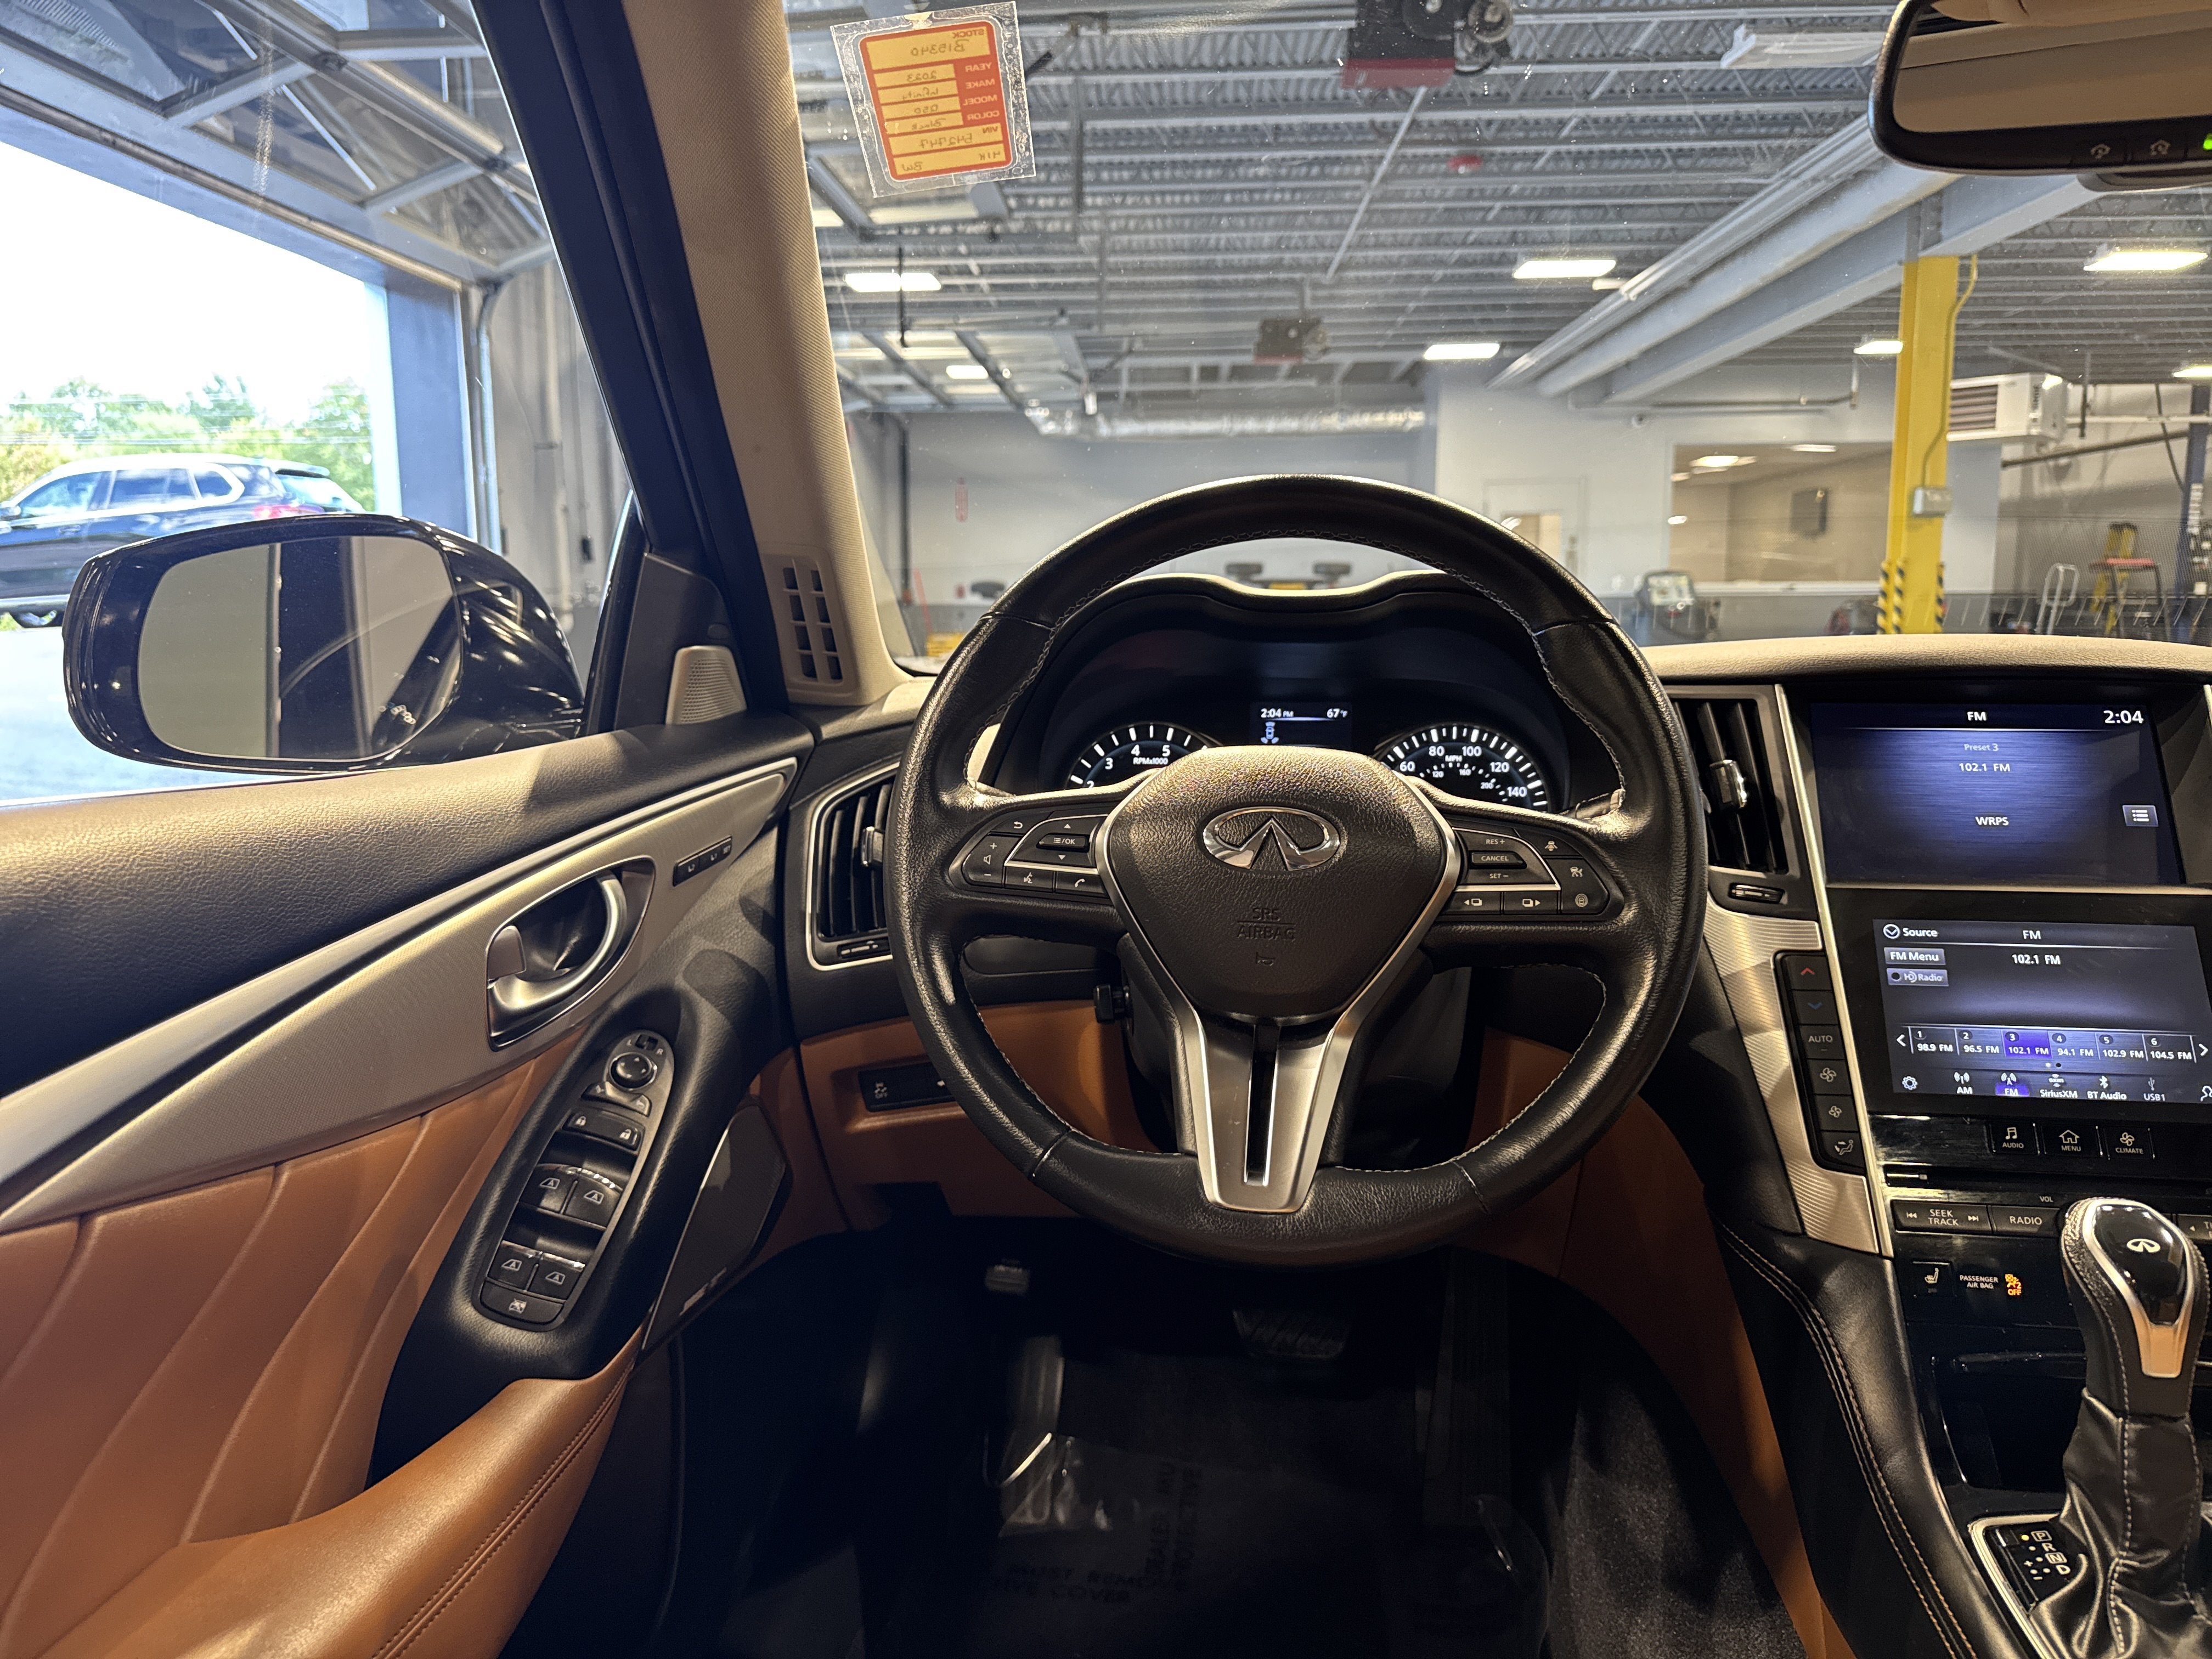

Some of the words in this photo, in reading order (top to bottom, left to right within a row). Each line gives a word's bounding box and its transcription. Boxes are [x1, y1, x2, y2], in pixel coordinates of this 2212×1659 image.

[1261, 708, 1282, 718] 2:04
[1967, 711, 1987, 722] FM
[2103, 710, 2144, 724] 2:04
[1131, 744, 1140, 756] 4
[1162, 744, 1170, 757] 5
[1429, 746, 1444, 757] 80
[1462, 746, 1482, 757] 100
[1964, 743, 1990, 752] Preset
[1992, 743, 1999, 752] 3
[1105, 758, 1113, 770] 3
[1400, 760, 1415, 772] 60
[1489, 761, 1509, 773] 120
[1959, 763, 1988, 772] 102.1
[1993, 763, 2011, 772] FM
[1506, 786, 1527, 798] 140
[1975, 816, 2009, 827] WRPS
[1902, 928, 1938, 937] Source
[2022, 930, 2041, 940] FM
[1890, 951, 1906, 960] FM
[1909, 952, 1939, 961] Menu
[2012, 954, 2040, 964] 102.1
[2045, 955, 2061, 965] FM
[1918, 974, 1943, 982] Radio
[1808, 1034, 1833, 1043] AUTO
[2009, 1033, 2016, 1041] 3
[2151, 1037, 2157, 1046] 6
[1963, 1045, 1982, 1053] 96.5
[2008, 1046, 2031, 1054] 102.1
[2079, 1048, 2094, 1057] FM
[2102, 1049, 2126, 1058] 102.9
[2130, 1050, 2144, 1058] FM
[2150, 1051, 2174, 1059] 104.5
[2177, 1052, 2192, 1060] FM
[1956, 1086, 1973, 1094] AM
[2004, 1088, 2018, 1096] FM
[2040, 1089, 2078, 1099] SiriusXM
[2087, 1091, 2098, 1099] BT
[2100, 1091, 2127, 1100] Audio
[2143, 1093, 2165, 1102] USB1
[1929, 1209, 1954, 1218] SEEK
[1928, 1217, 1959, 1226] TRACK
[2010, 1215, 2042, 1226] RADIO
[1959, 1274, 1999, 1283] PASSENGER
[2041, 1542, 2057, 1552] R
[2056, 1565, 2071, 1575] D
